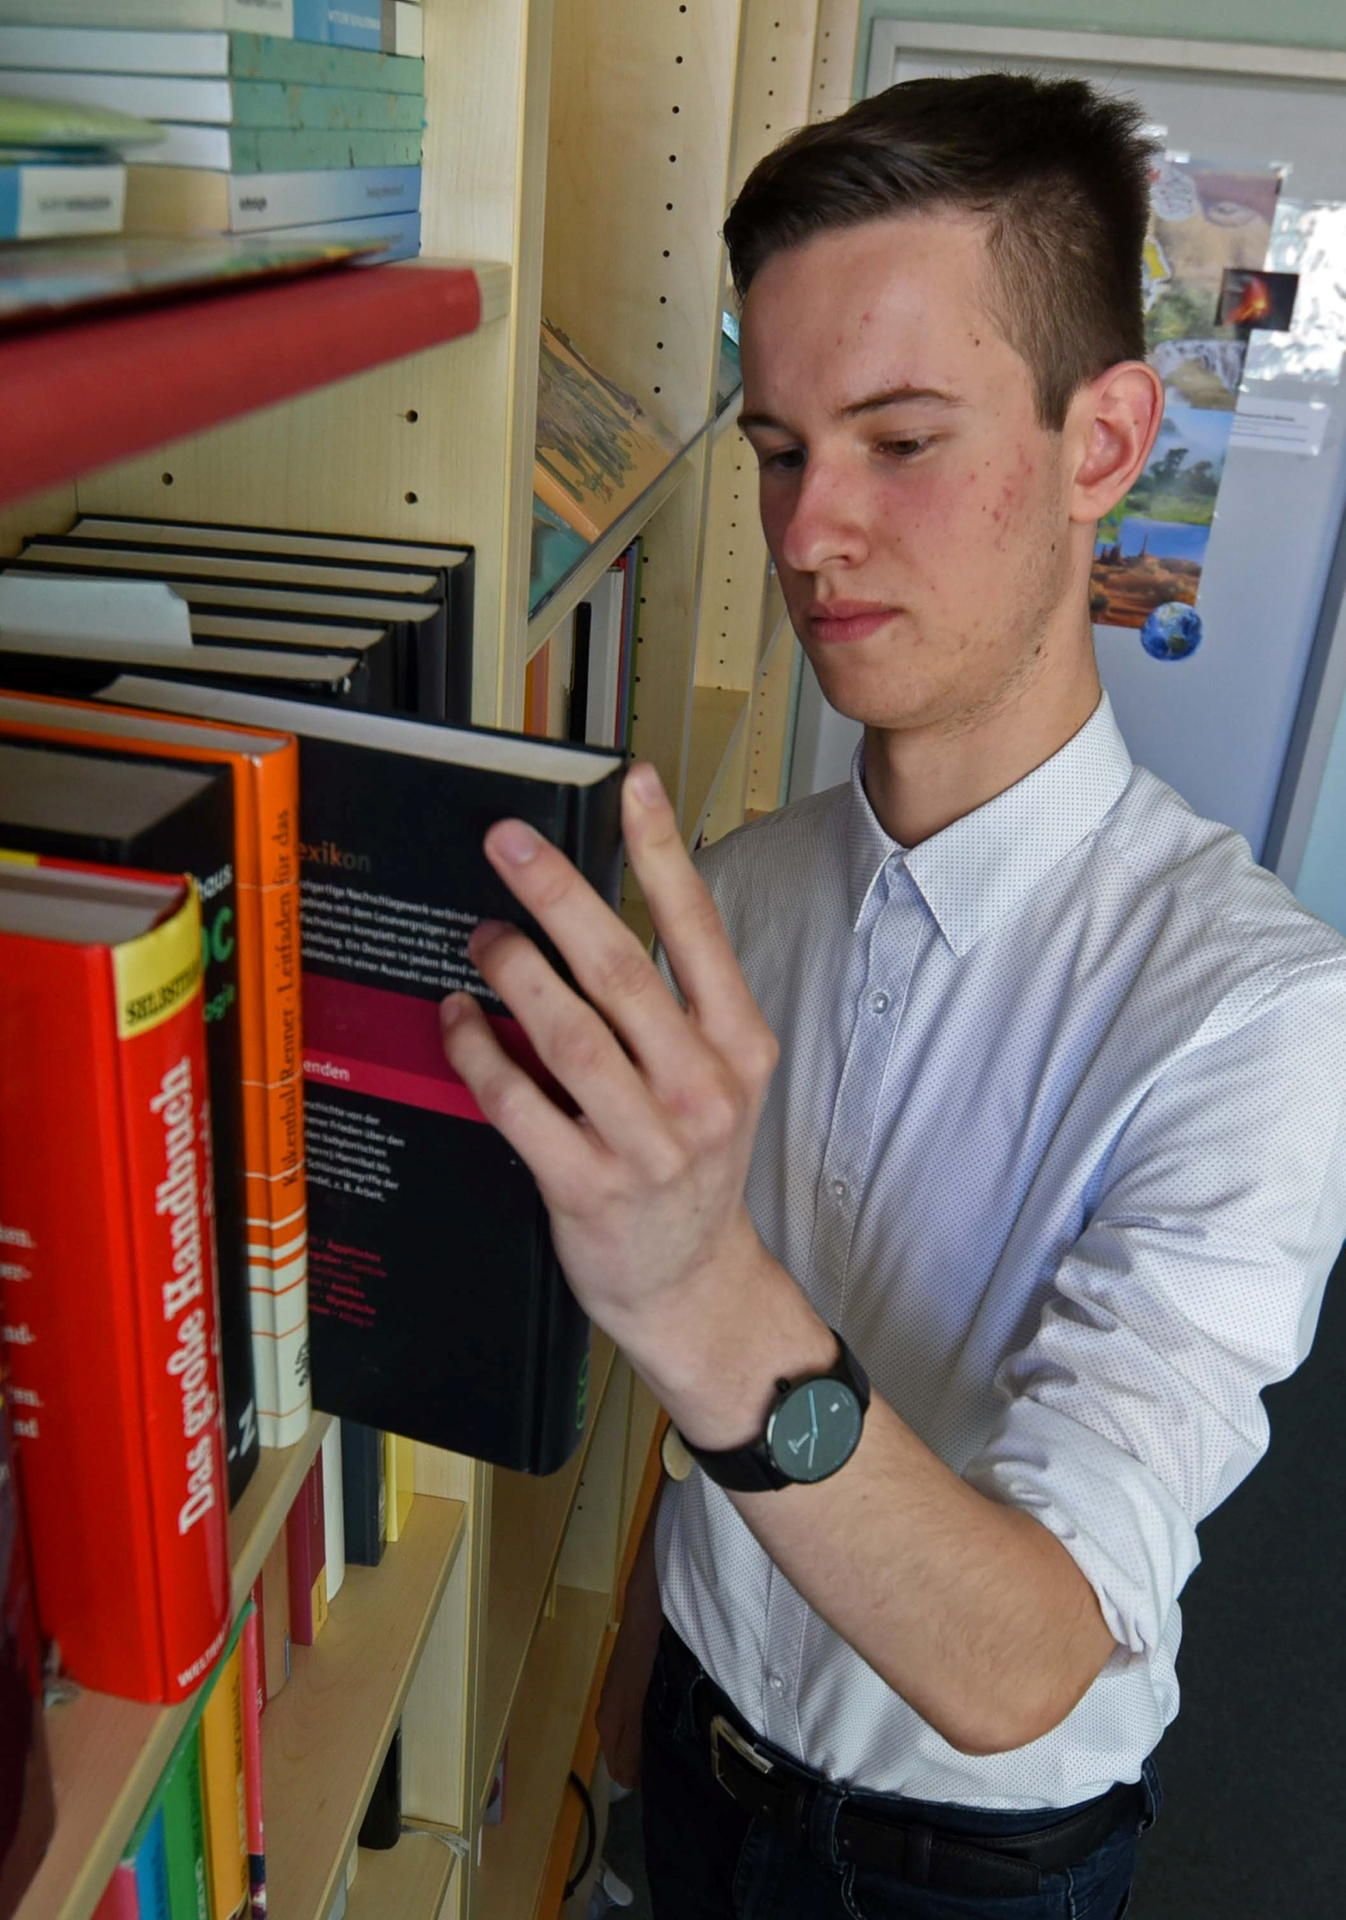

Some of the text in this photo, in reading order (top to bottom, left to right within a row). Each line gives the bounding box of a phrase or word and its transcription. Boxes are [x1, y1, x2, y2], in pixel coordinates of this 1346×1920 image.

[272, 810, 290, 845] das
[274, 891, 295, 993] Leitfaden
[150, 1057, 216, 1534] Das große Handbuch
